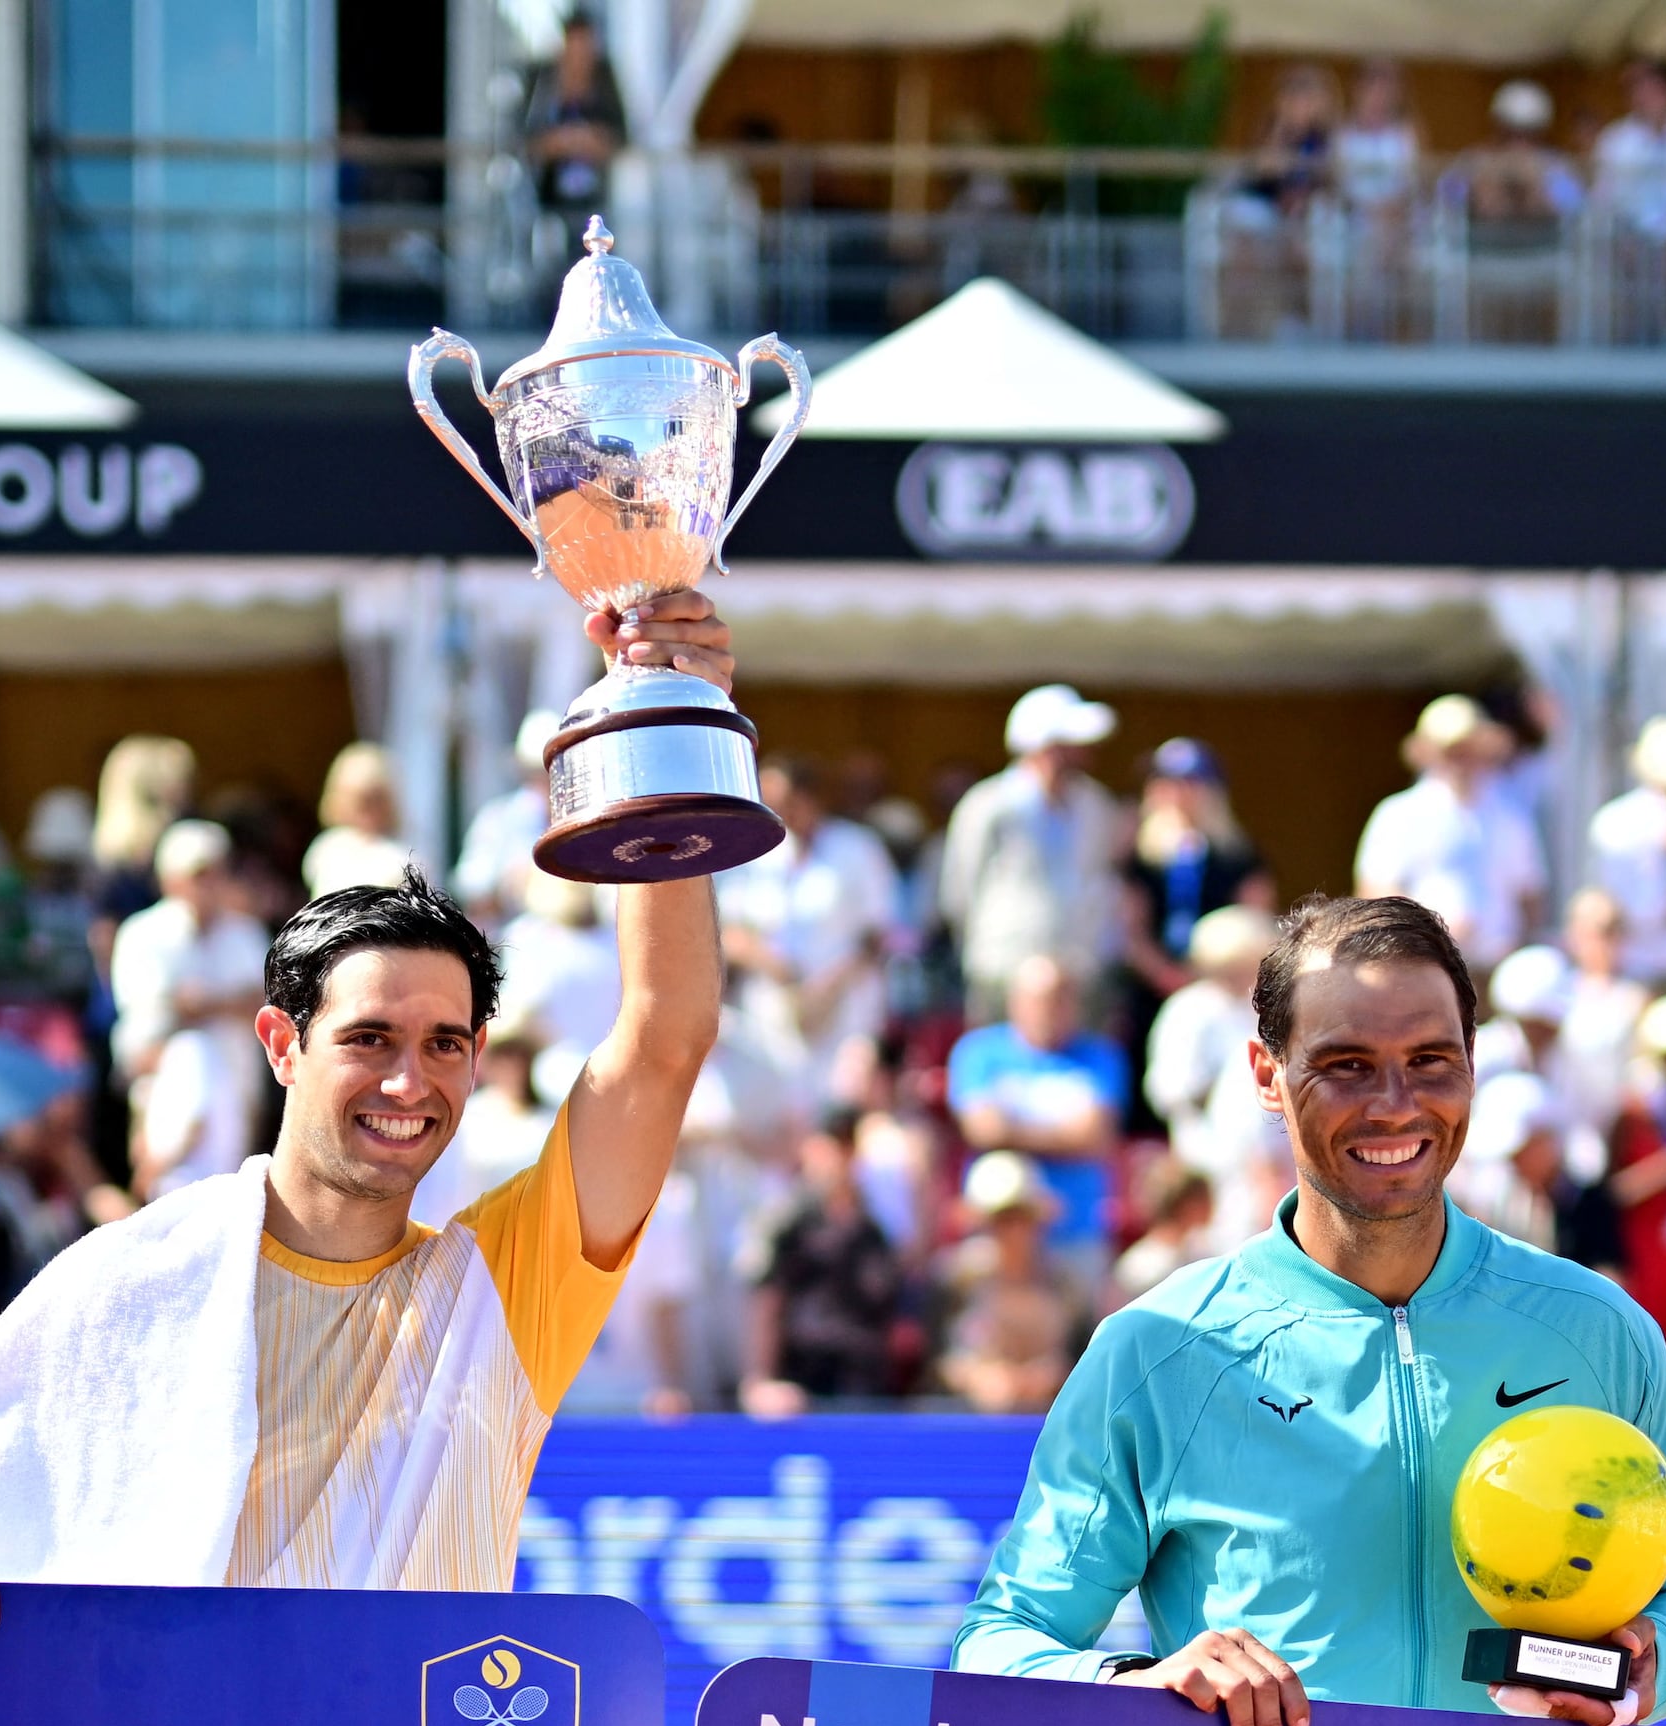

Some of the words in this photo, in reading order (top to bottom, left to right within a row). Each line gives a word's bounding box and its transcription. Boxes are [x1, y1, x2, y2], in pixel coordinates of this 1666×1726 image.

[931, 453, 1163, 544] EAB
[1528, 1643, 1563, 1657] RUNNER
[1564, 1651, 1577, 1660] UP
[1578, 1652, 1613, 1666] SINGLES
